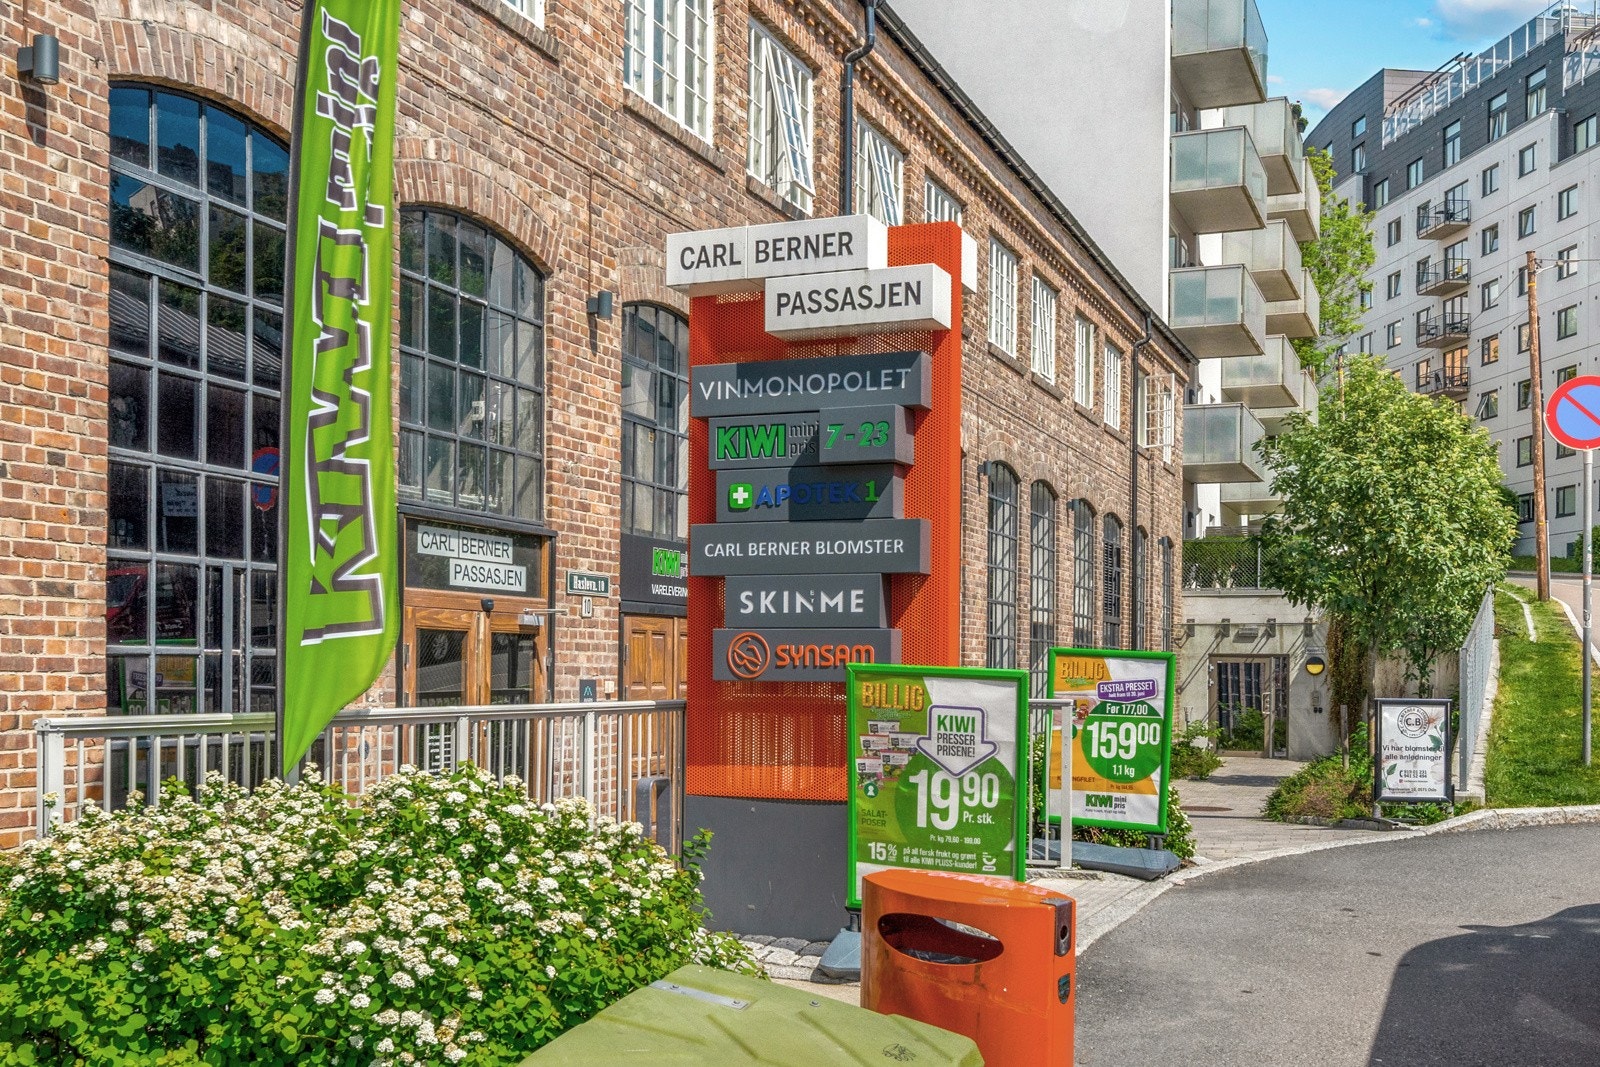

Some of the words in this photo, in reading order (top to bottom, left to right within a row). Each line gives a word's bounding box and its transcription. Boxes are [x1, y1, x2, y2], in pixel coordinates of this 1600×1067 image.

[680, 241, 742, 271] CARL
[754, 231, 854, 264] BERNER
[776, 280, 922, 317] PASSASJEN
[699, 368, 911, 400] VINMONOPOLET
[300, 215, 385, 646] KIWI
[716, 423, 787, 461] KIWI
[755, 481, 861, 507] APOTEK
[421, 531, 455, 552] CARL
[461, 536, 510, 559] BERNER
[704, 543, 743, 558] CARL
[749, 541, 810, 556] BERNER
[815, 539, 904, 555] BLOMSTER
[652, 547, 681, 578] KIWI
[454, 563, 522, 587] PASSASJEN
[651, 584, 688, 598] VARELEVERIN
[584, 598, 591, 614] 10
[775, 644, 875, 668] SYNSAM
[1060, 661, 1105, 680] BILLIG
[1100, 683, 1125, 693] EKSTRA
[1126, 682, 1153, 692] PRESSET
[861, 682, 925, 712] BILLIG
[1106, 703, 1120, 714] Før
[1121, 704, 1148, 715] 177,00
[937, 714, 976, 733] KIWI
[1406, 718, 1421, 726] C.B
[937, 733, 976, 746] PRESSER
[937, 744, 976, 758] PRISENE!
[1400, 754, 1442, 762] anledninger
[1112, 764, 1122, 776] 1,1
[1124, 765, 1135, 778] kg
[1085, 794, 1113, 808] KIWI
[861, 809, 888, 818] SALAT-
[963, 811, 974, 822] Pr.
[977, 813, 995, 824] stk.
[861, 818, 887, 827] POSER
[903, 847, 910, 855] på
[919, 848, 935, 856] fersk
[935, 849, 951, 858] frukt
[952, 852, 959, 860] og
[921, 857, 934, 866] KIWI
